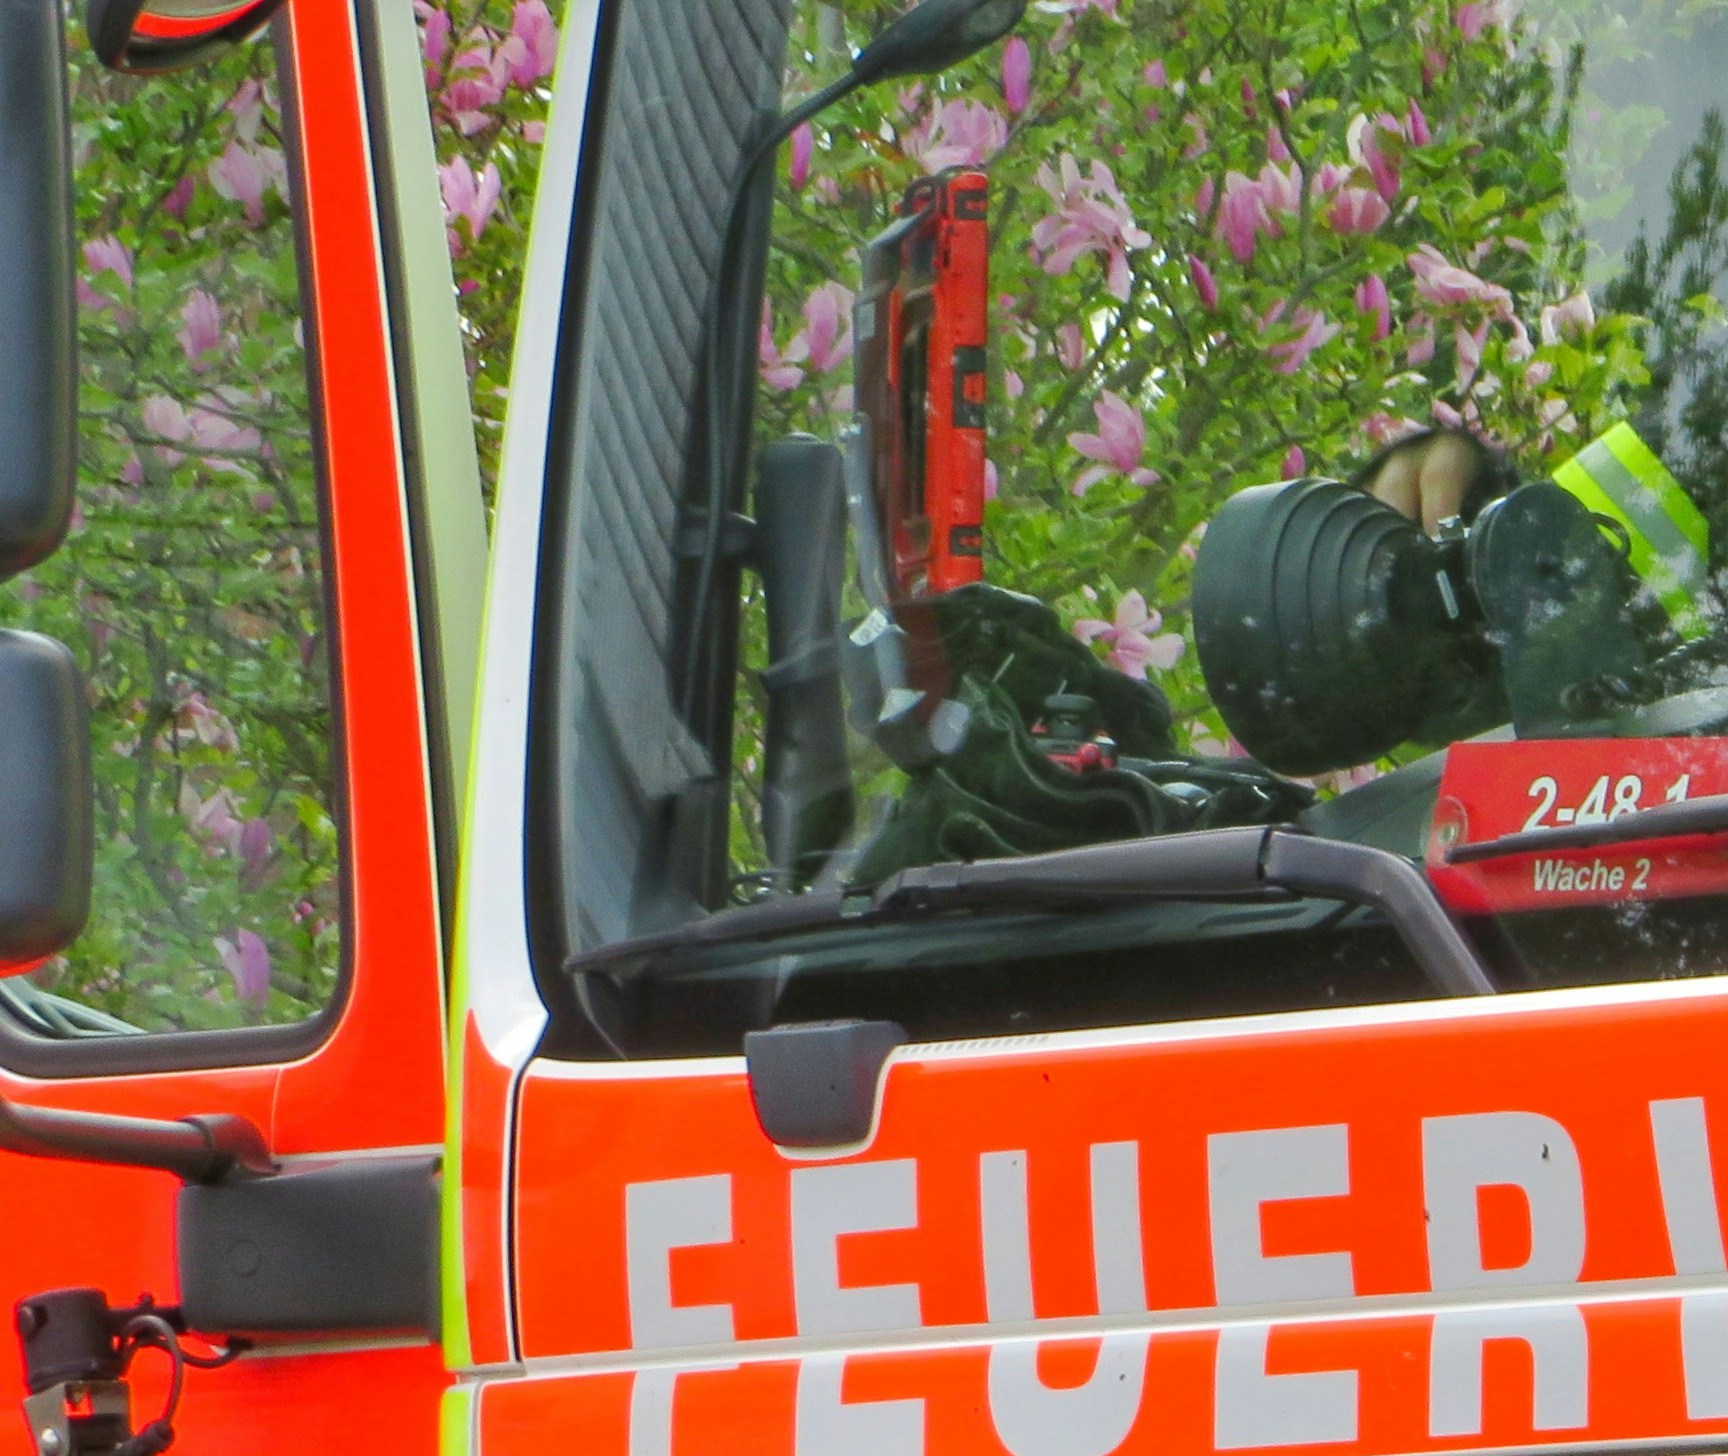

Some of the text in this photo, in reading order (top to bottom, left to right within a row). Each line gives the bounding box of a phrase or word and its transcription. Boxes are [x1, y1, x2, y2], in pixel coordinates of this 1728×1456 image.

[1520, 773, 1691, 834] 2-481
[1532, 857, 1652, 892] Wache 2
